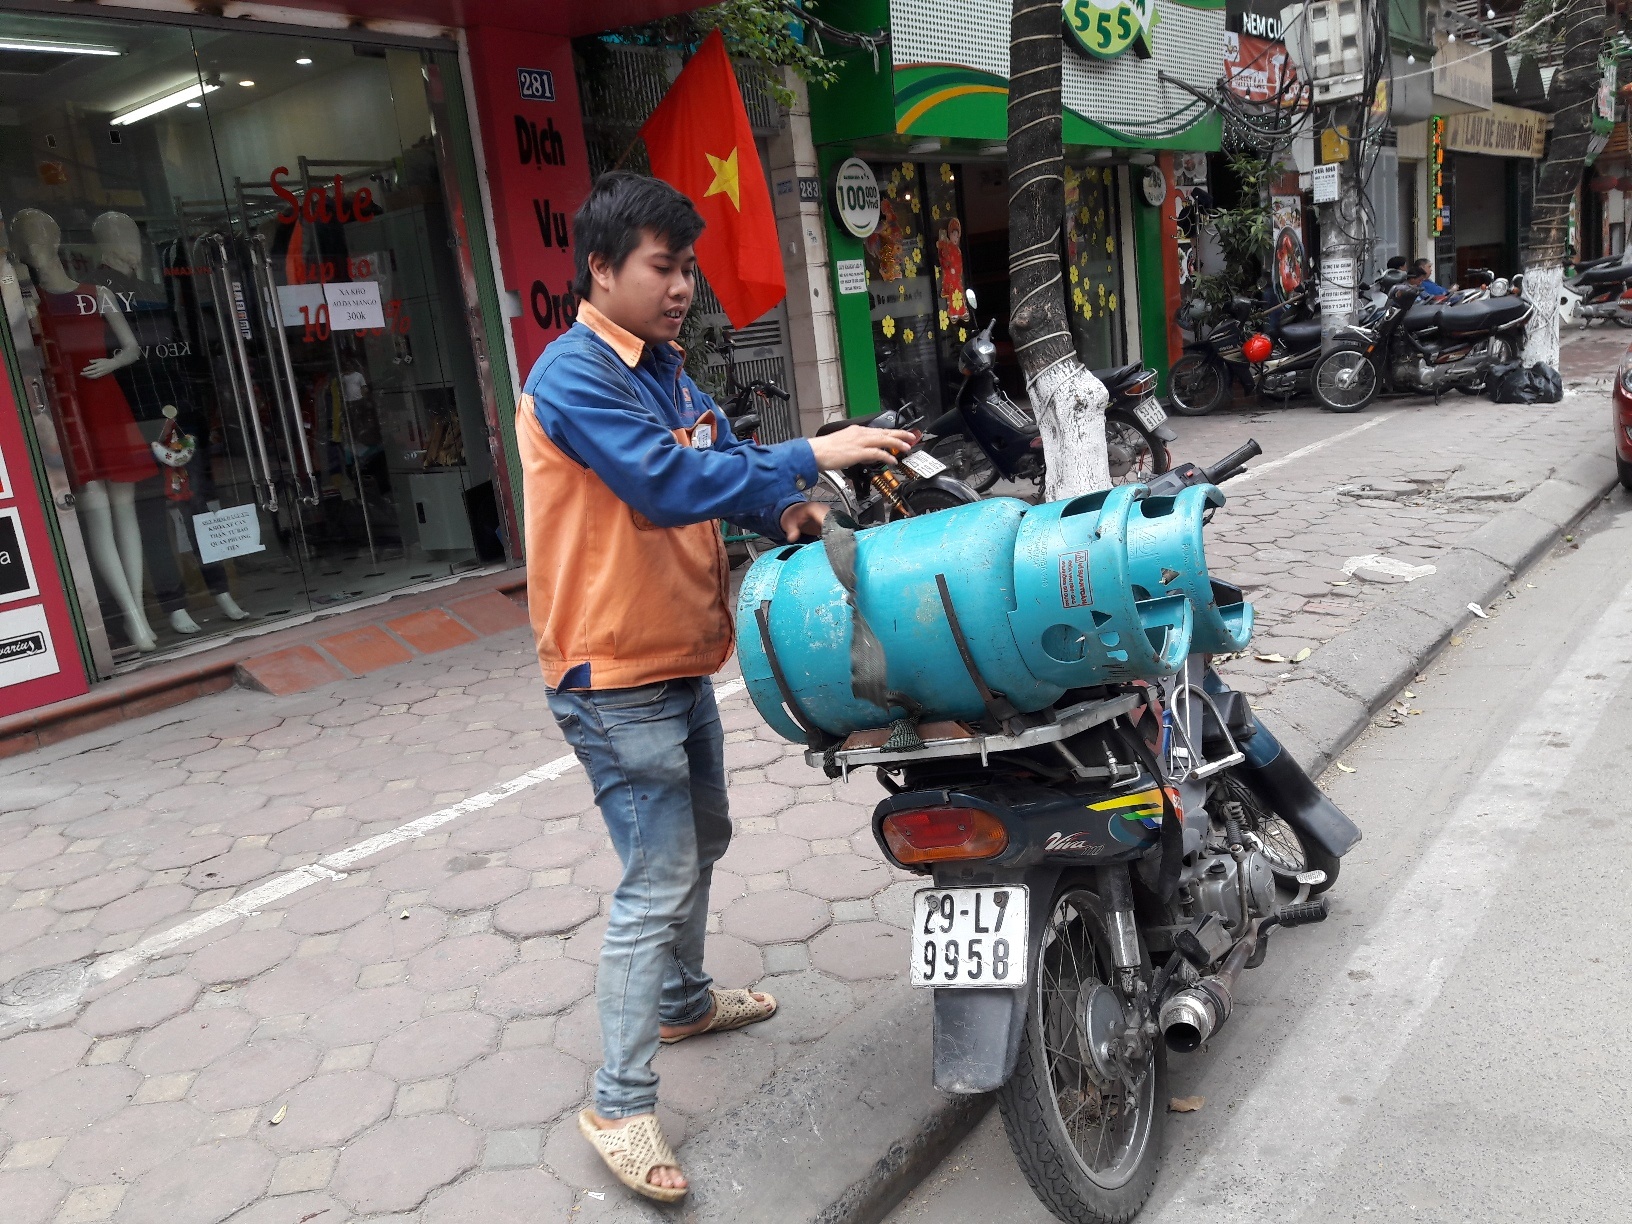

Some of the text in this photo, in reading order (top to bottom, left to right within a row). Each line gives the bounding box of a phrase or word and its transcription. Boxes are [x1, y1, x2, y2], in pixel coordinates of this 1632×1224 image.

[1074, 0, 1132, 49] 555
[1242, 11, 1266, 37] NEM
[520, 73, 552, 97] 281
[514, 114, 566, 170] Dịch
[270, 166, 375, 225] Sale
[800, 181, 819, 198] 283
[838, 185, 865, 211] 100
[533, 199, 570, 253] Vụ
[347, 256, 371, 279] to
[75, 279, 136, 316] ĐẨY
[346, 311, 366, 321] 300k
[299, 303, 330, 343] 10
[1044, 832, 1088, 851] Viva
[924, 890, 1010, 934] 29-L7
[923, 938, 1010, 980] 9958
